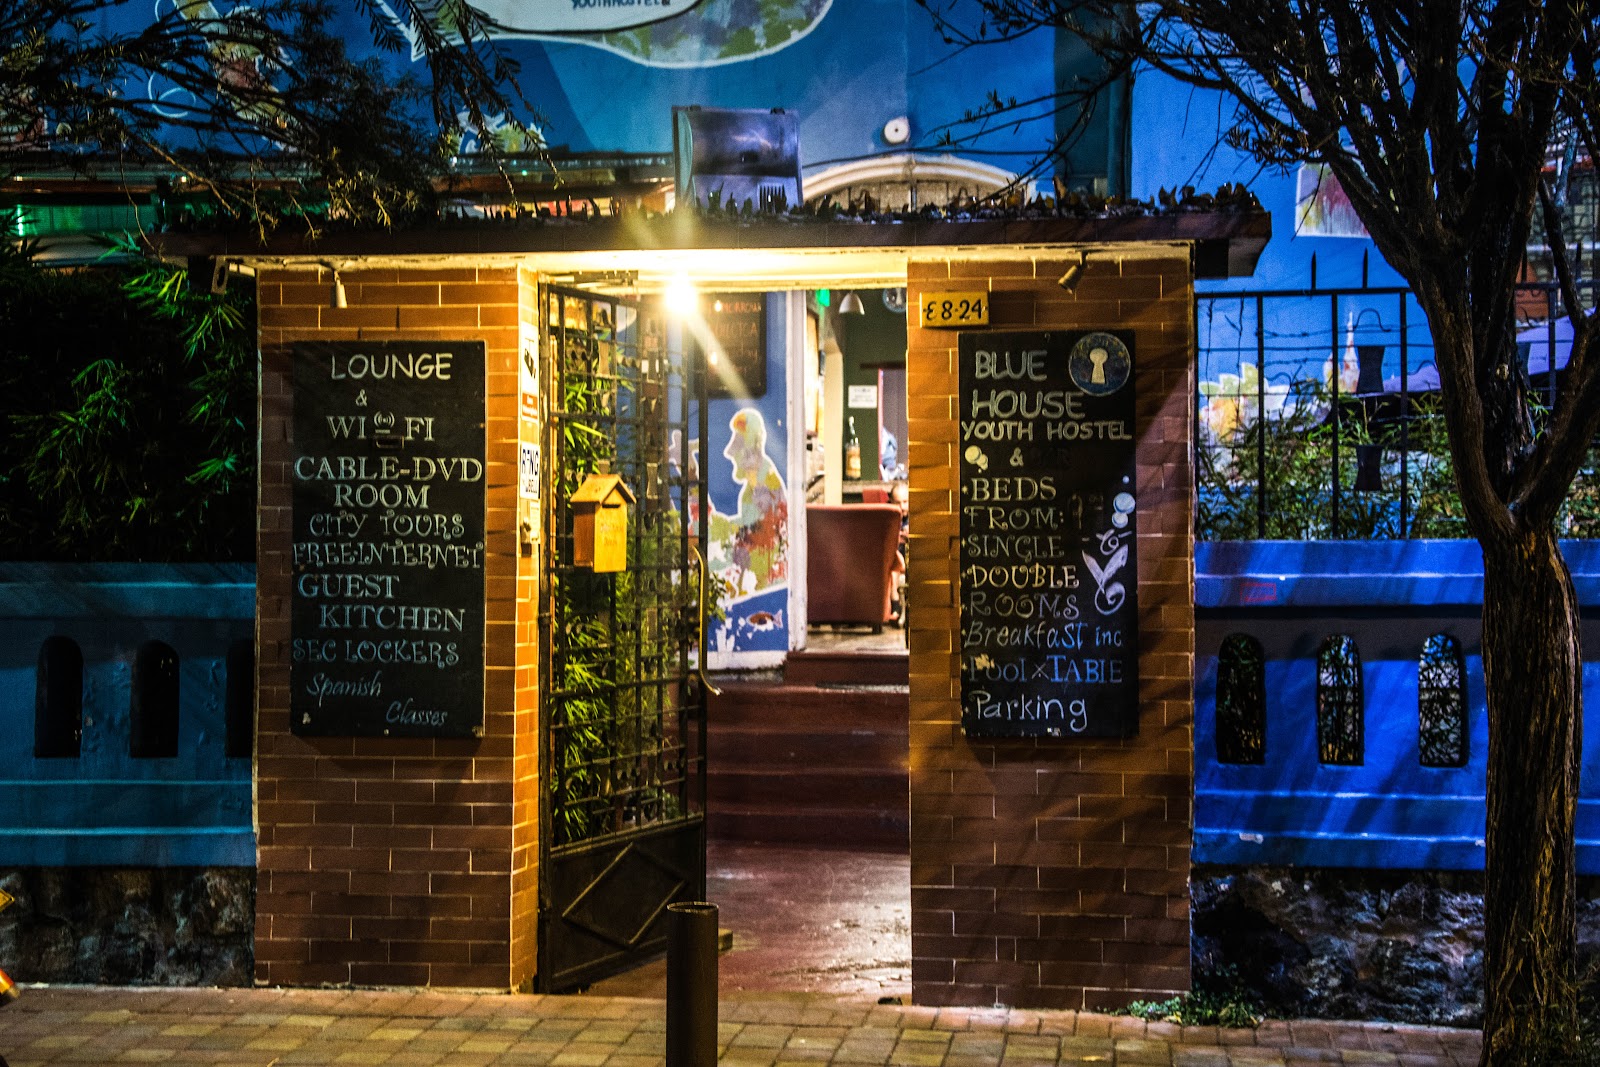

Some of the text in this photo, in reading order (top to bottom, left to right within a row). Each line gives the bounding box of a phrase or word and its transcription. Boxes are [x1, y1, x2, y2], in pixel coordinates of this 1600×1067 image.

[331, 353, 453, 380] LOUNGE
[975, 350, 1048, 382] BLUE
[355, 389, 368, 407] &
[972, 388, 1086, 421] HOUSE
[961, 420, 1132, 442] YOUTH HOSTEL
[294, 456, 482, 482] CABLE-DVD
[1009, 447, 1024, 467] &
[333, 483, 430, 509] ROOM
[971, 476, 1057, 502] BEDS
[309, 510, 465, 540] CITY TOURS
[967, 533, 1065, 563] SINGLE
[298, 573, 400, 599] GUEST
[966, 562, 1080, 589] DOUBLE
[319, 604, 465, 632] KITCHEN
[969, 591, 1080, 620] ROOMS
[293, 638, 460, 669] SEC LOCKERS
[306, 670, 383, 707] Spanish
[386, 698, 448, 726] Classes
[968, 689, 1088, 732] Parking
